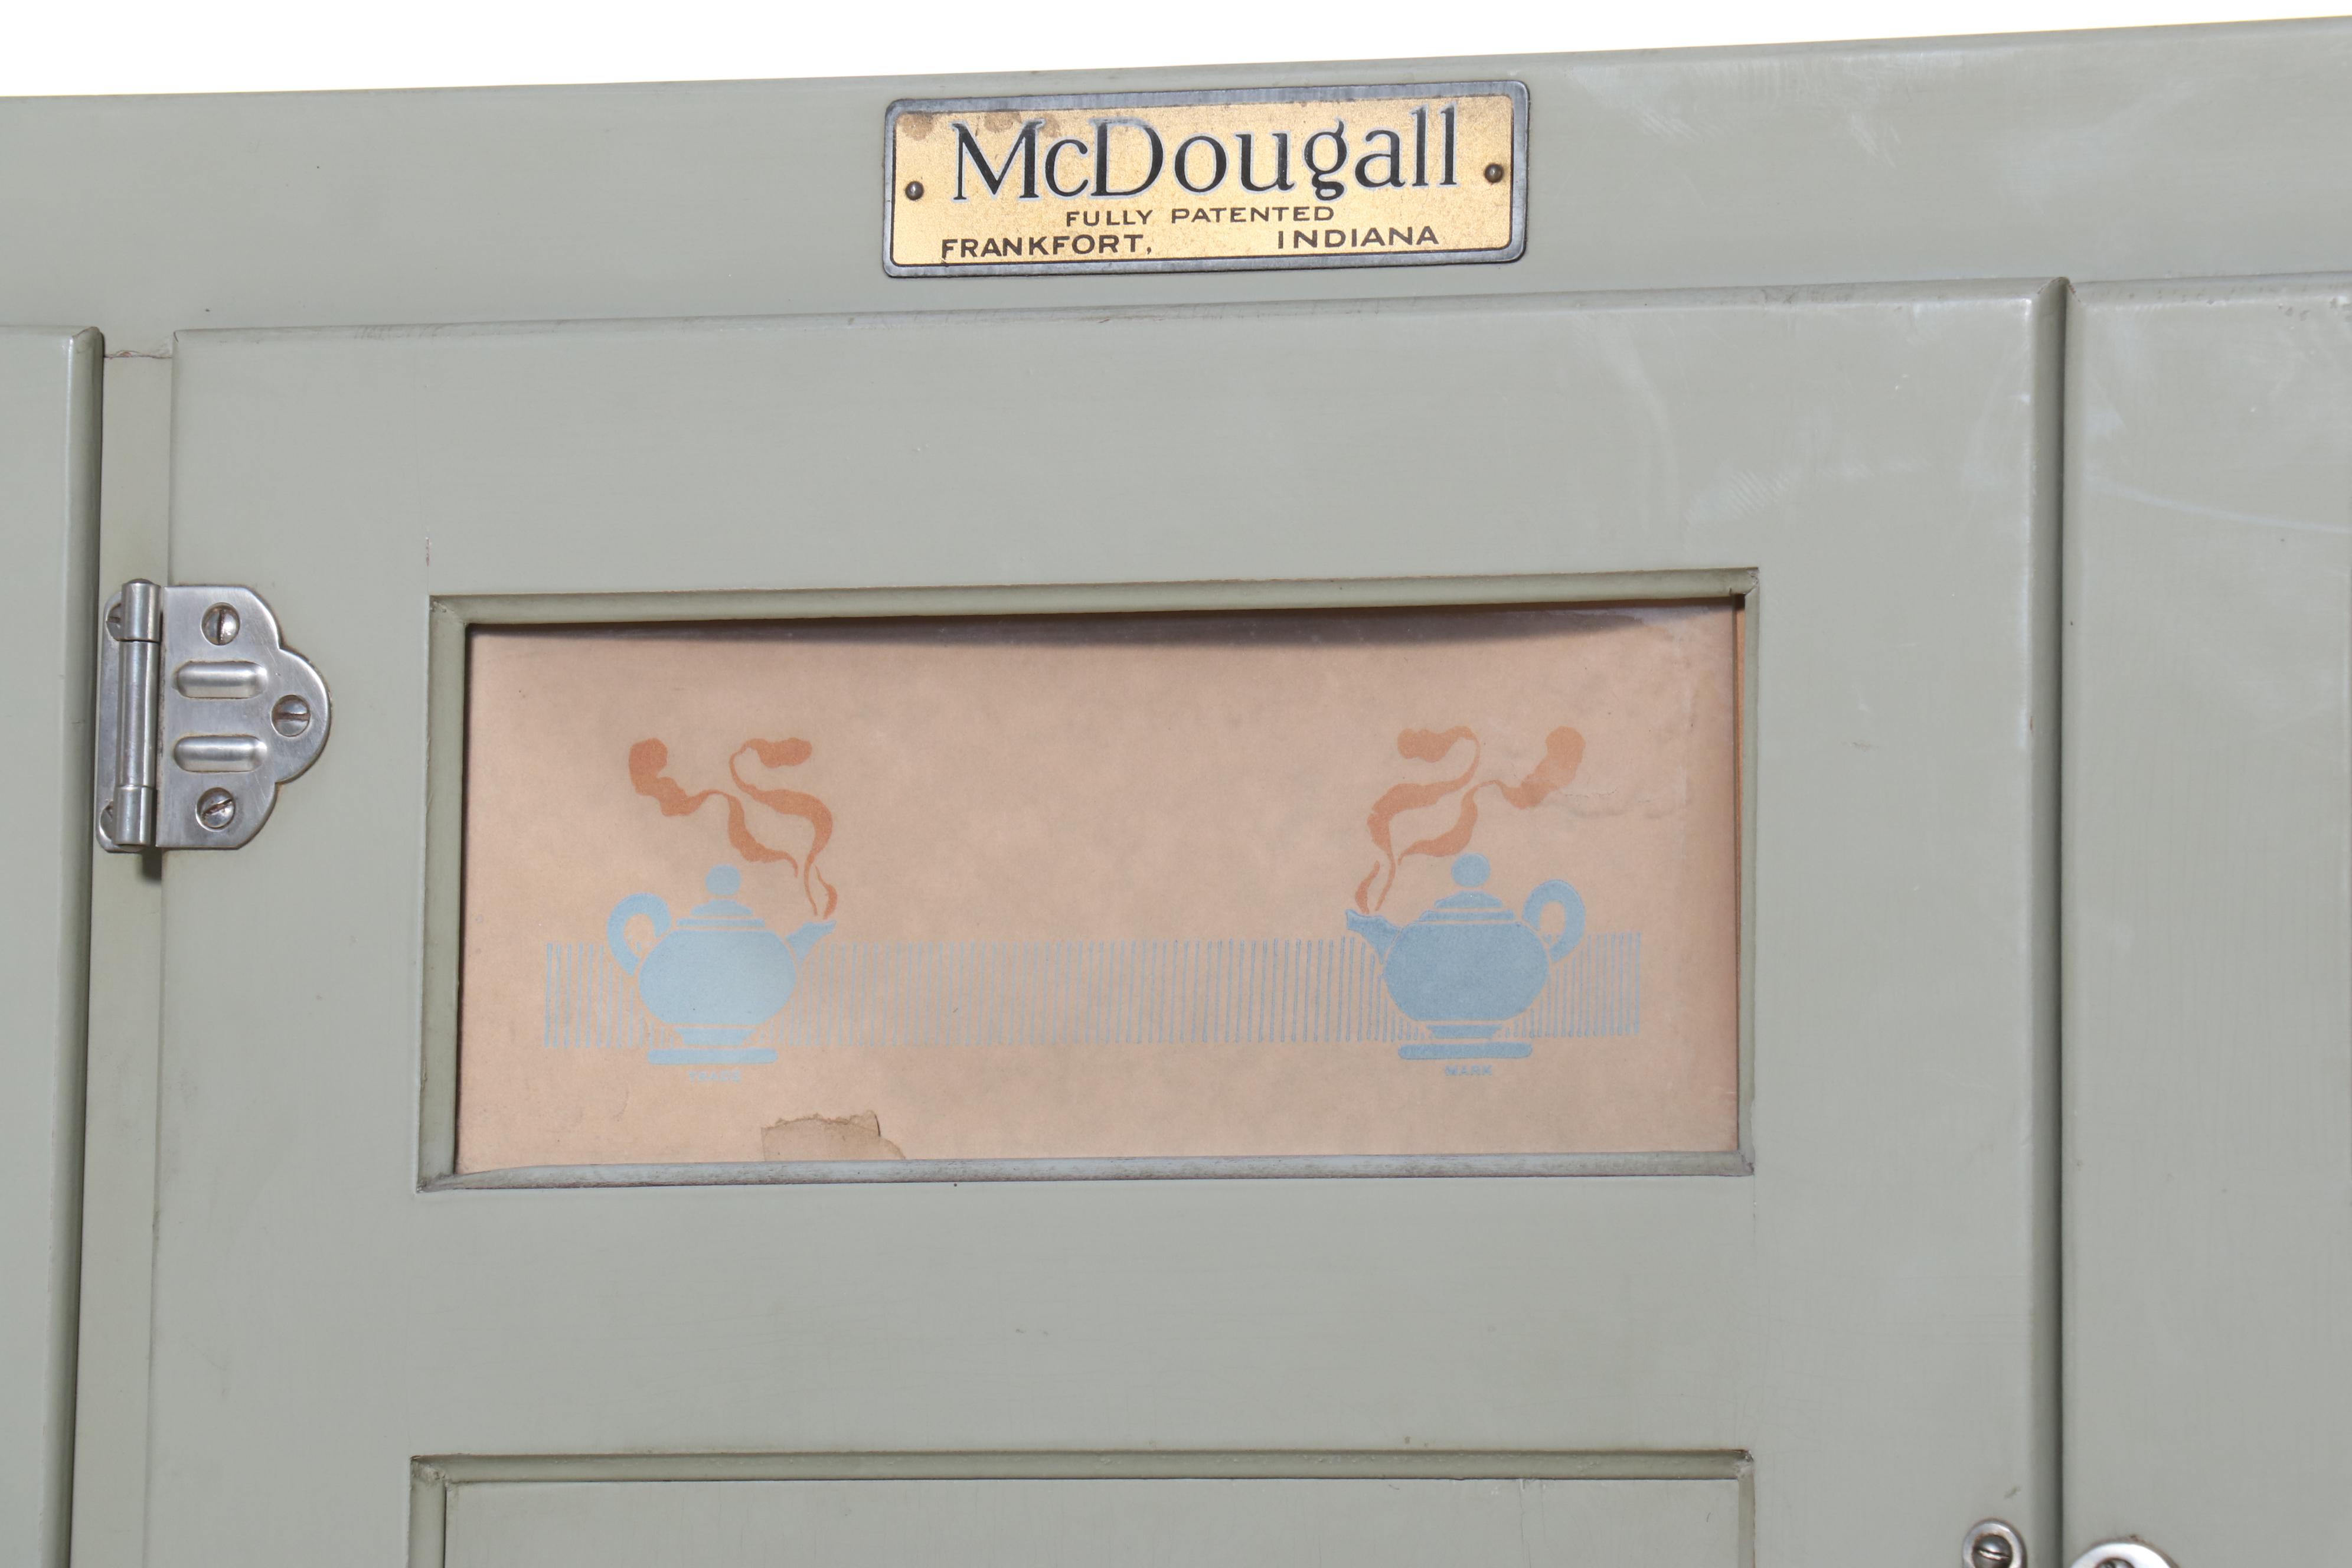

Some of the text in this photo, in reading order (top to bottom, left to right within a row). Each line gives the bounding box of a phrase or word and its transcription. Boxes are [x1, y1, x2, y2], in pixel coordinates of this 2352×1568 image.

[950, 103, 1458, 200] McDougall
[1066, 206, 1334, 227] FULLY PATENTED
[942, 226, 1439, 258] FRANKFORT, INDIANA
[1445, 1064, 1493, 1076] MARK
